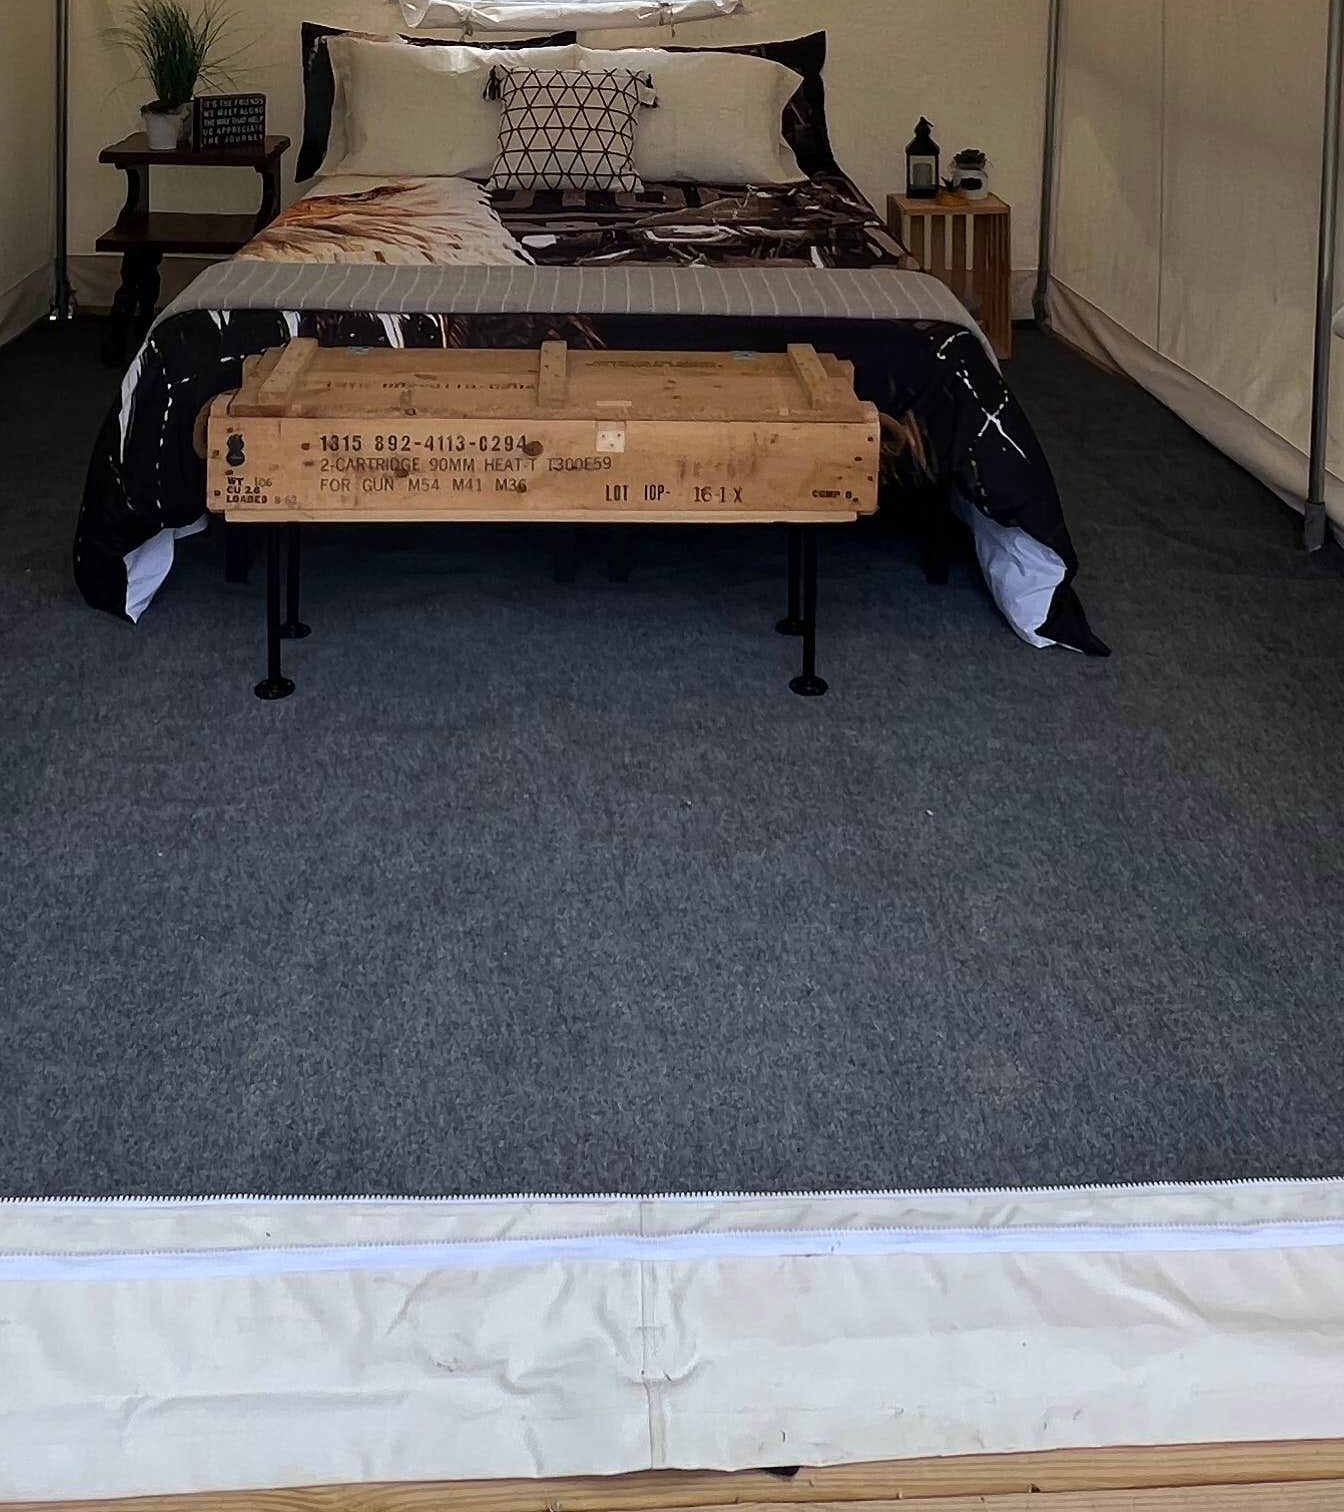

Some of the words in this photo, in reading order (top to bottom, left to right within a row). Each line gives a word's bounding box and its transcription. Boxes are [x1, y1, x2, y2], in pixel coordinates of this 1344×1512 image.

[429, 456, 475, 472] 90MM
[320, 478, 351, 492] FOR
[362, 477, 394, 492] GUN
[408, 478, 439, 492] M54
[452, 478, 482, 492] M41
[226, 494, 268, 504] LOADED
[605, 484, 629, 502] LOT
